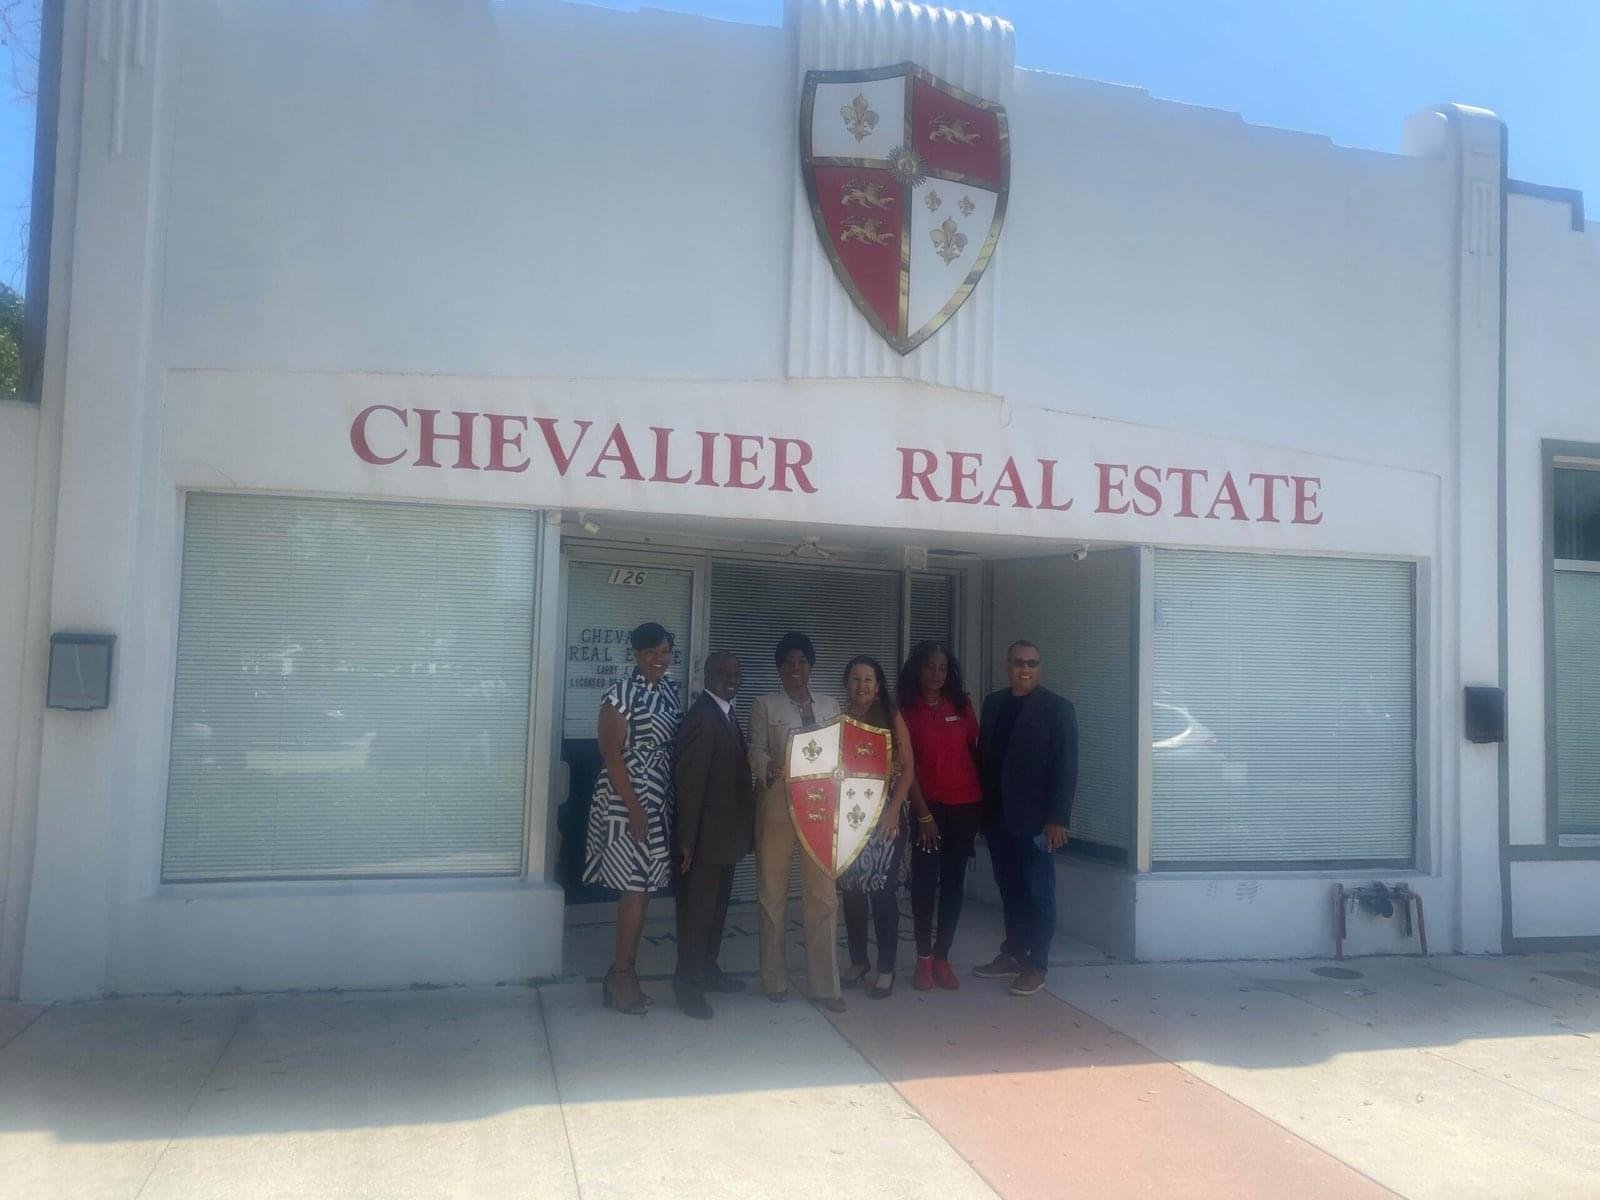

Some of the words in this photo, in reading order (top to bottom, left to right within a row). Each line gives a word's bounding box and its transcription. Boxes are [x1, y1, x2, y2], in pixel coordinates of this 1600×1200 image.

[350, 404, 820, 494] CHEVALIER
[895, 447, 1074, 512] REAL
[1093, 462, 1324, 526] ESTATE
[612, 569, 647, 585] 126
[568, 645, 613, 662] REAL
